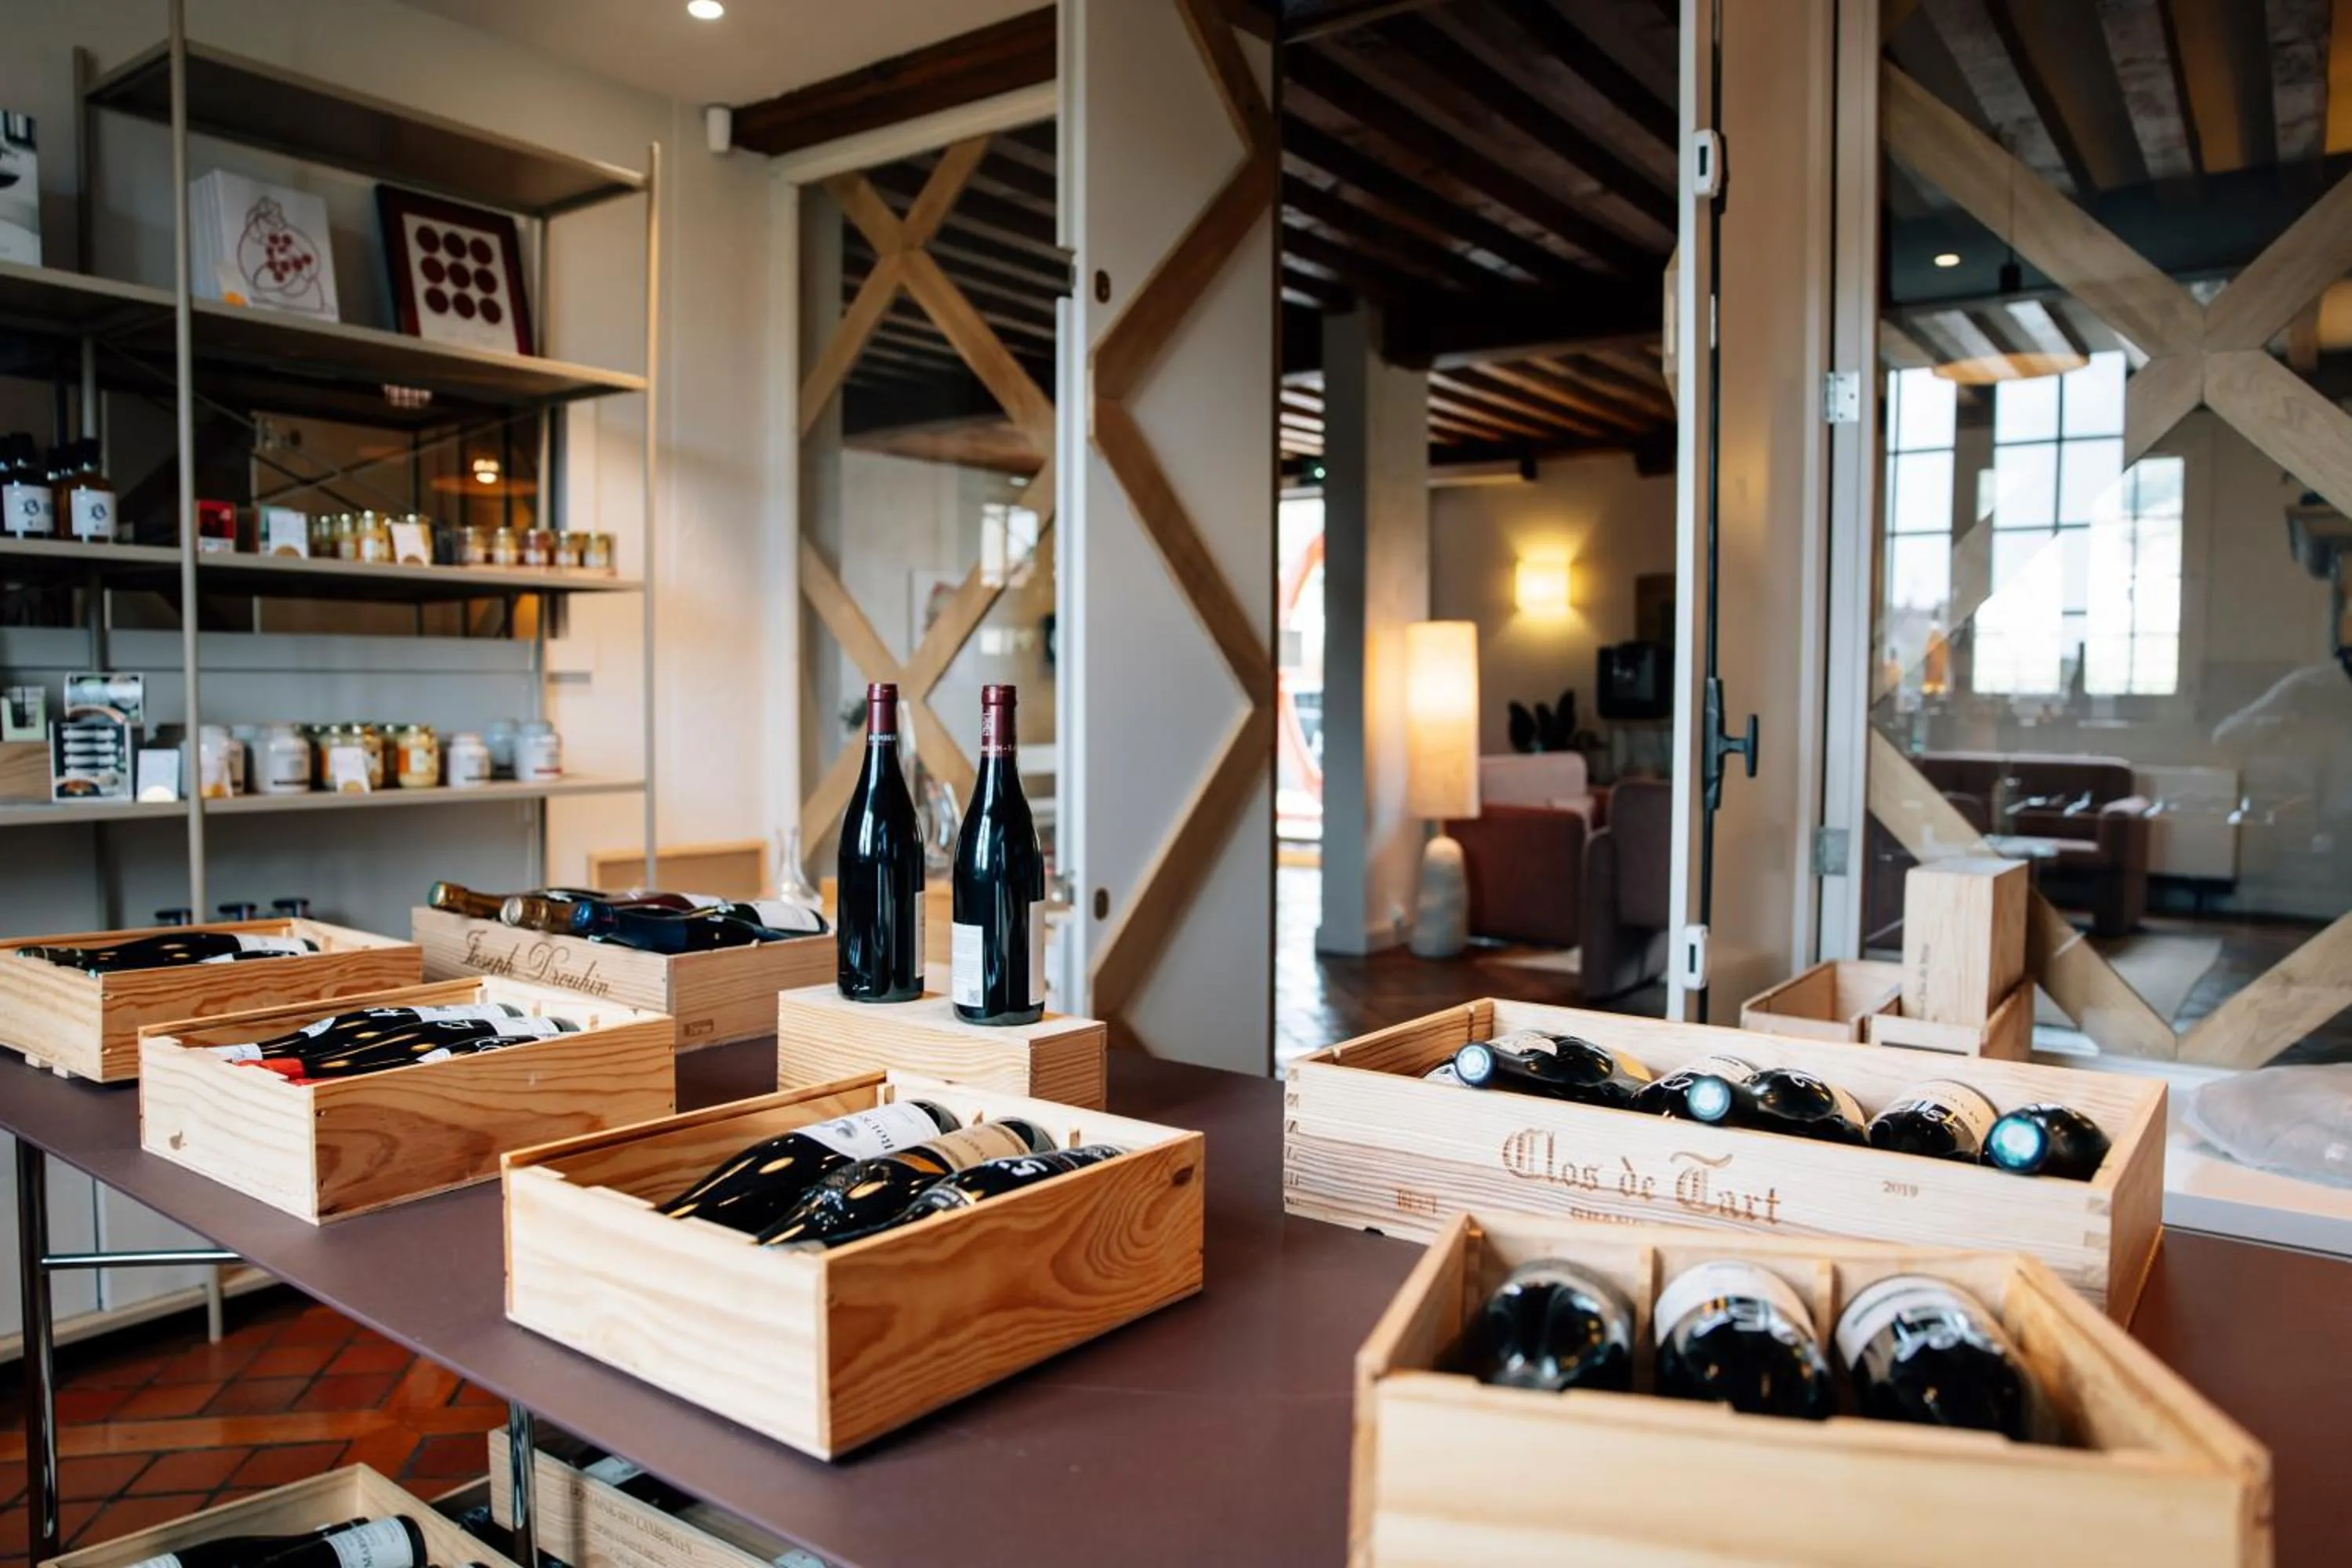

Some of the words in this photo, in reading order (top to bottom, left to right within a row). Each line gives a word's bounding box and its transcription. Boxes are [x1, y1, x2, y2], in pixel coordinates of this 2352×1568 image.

[462, 929, 521, 974] Joseph
[523, 942, 609, 996] Drouhin
[1501, 1128, 1602, 1190] Clos
[1619, 1156, 1655, 1200] de
[1669, 1151, 1780, 1224] Tart
